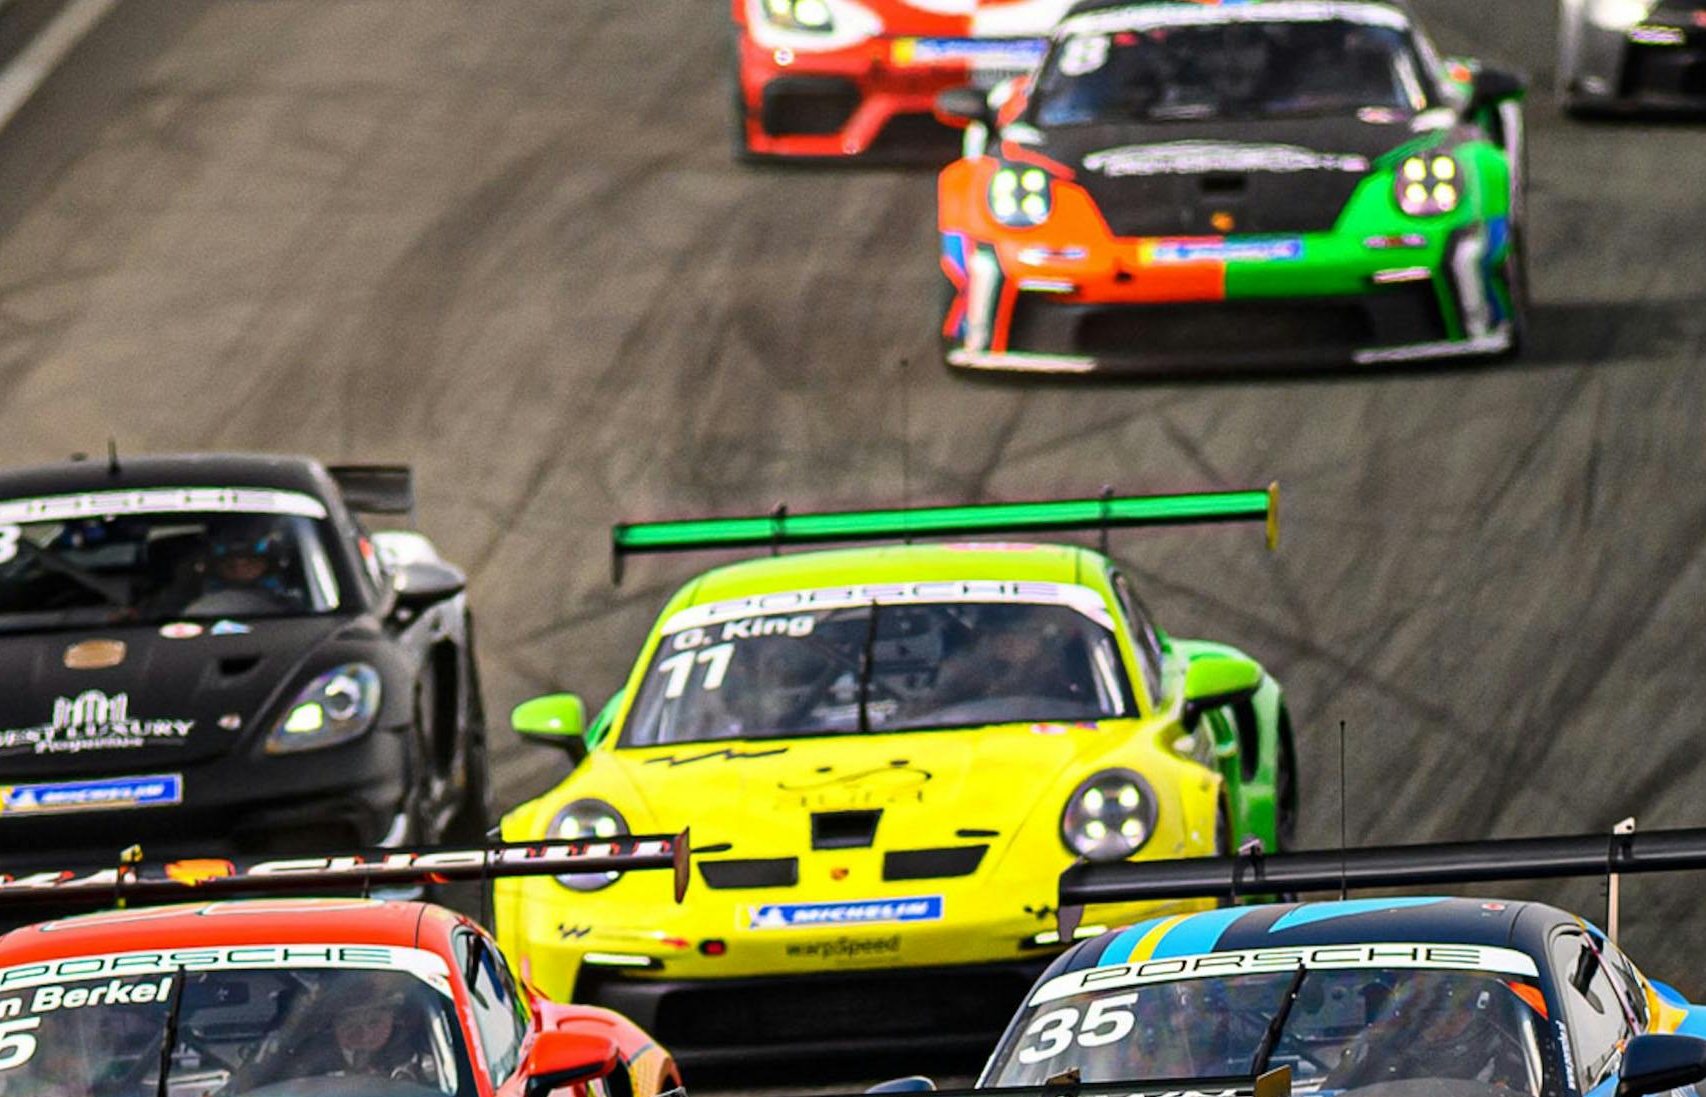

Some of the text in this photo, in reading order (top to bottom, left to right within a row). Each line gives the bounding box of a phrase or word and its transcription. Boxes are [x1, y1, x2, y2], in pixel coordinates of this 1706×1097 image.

[723, 615, 815, 642] King
[659, 641, 736, 699] 11
[792, 900, 929, 923] MICHELIN
[0, 946, 392, 986] PORSCHE
[786, 936, 901, 958] warpSpeed
[1079, 947, 1480, 988] PORSCHE
[31, 977, 173, 1014] Berkel
[1017, 993, 1139, 1065] 35
